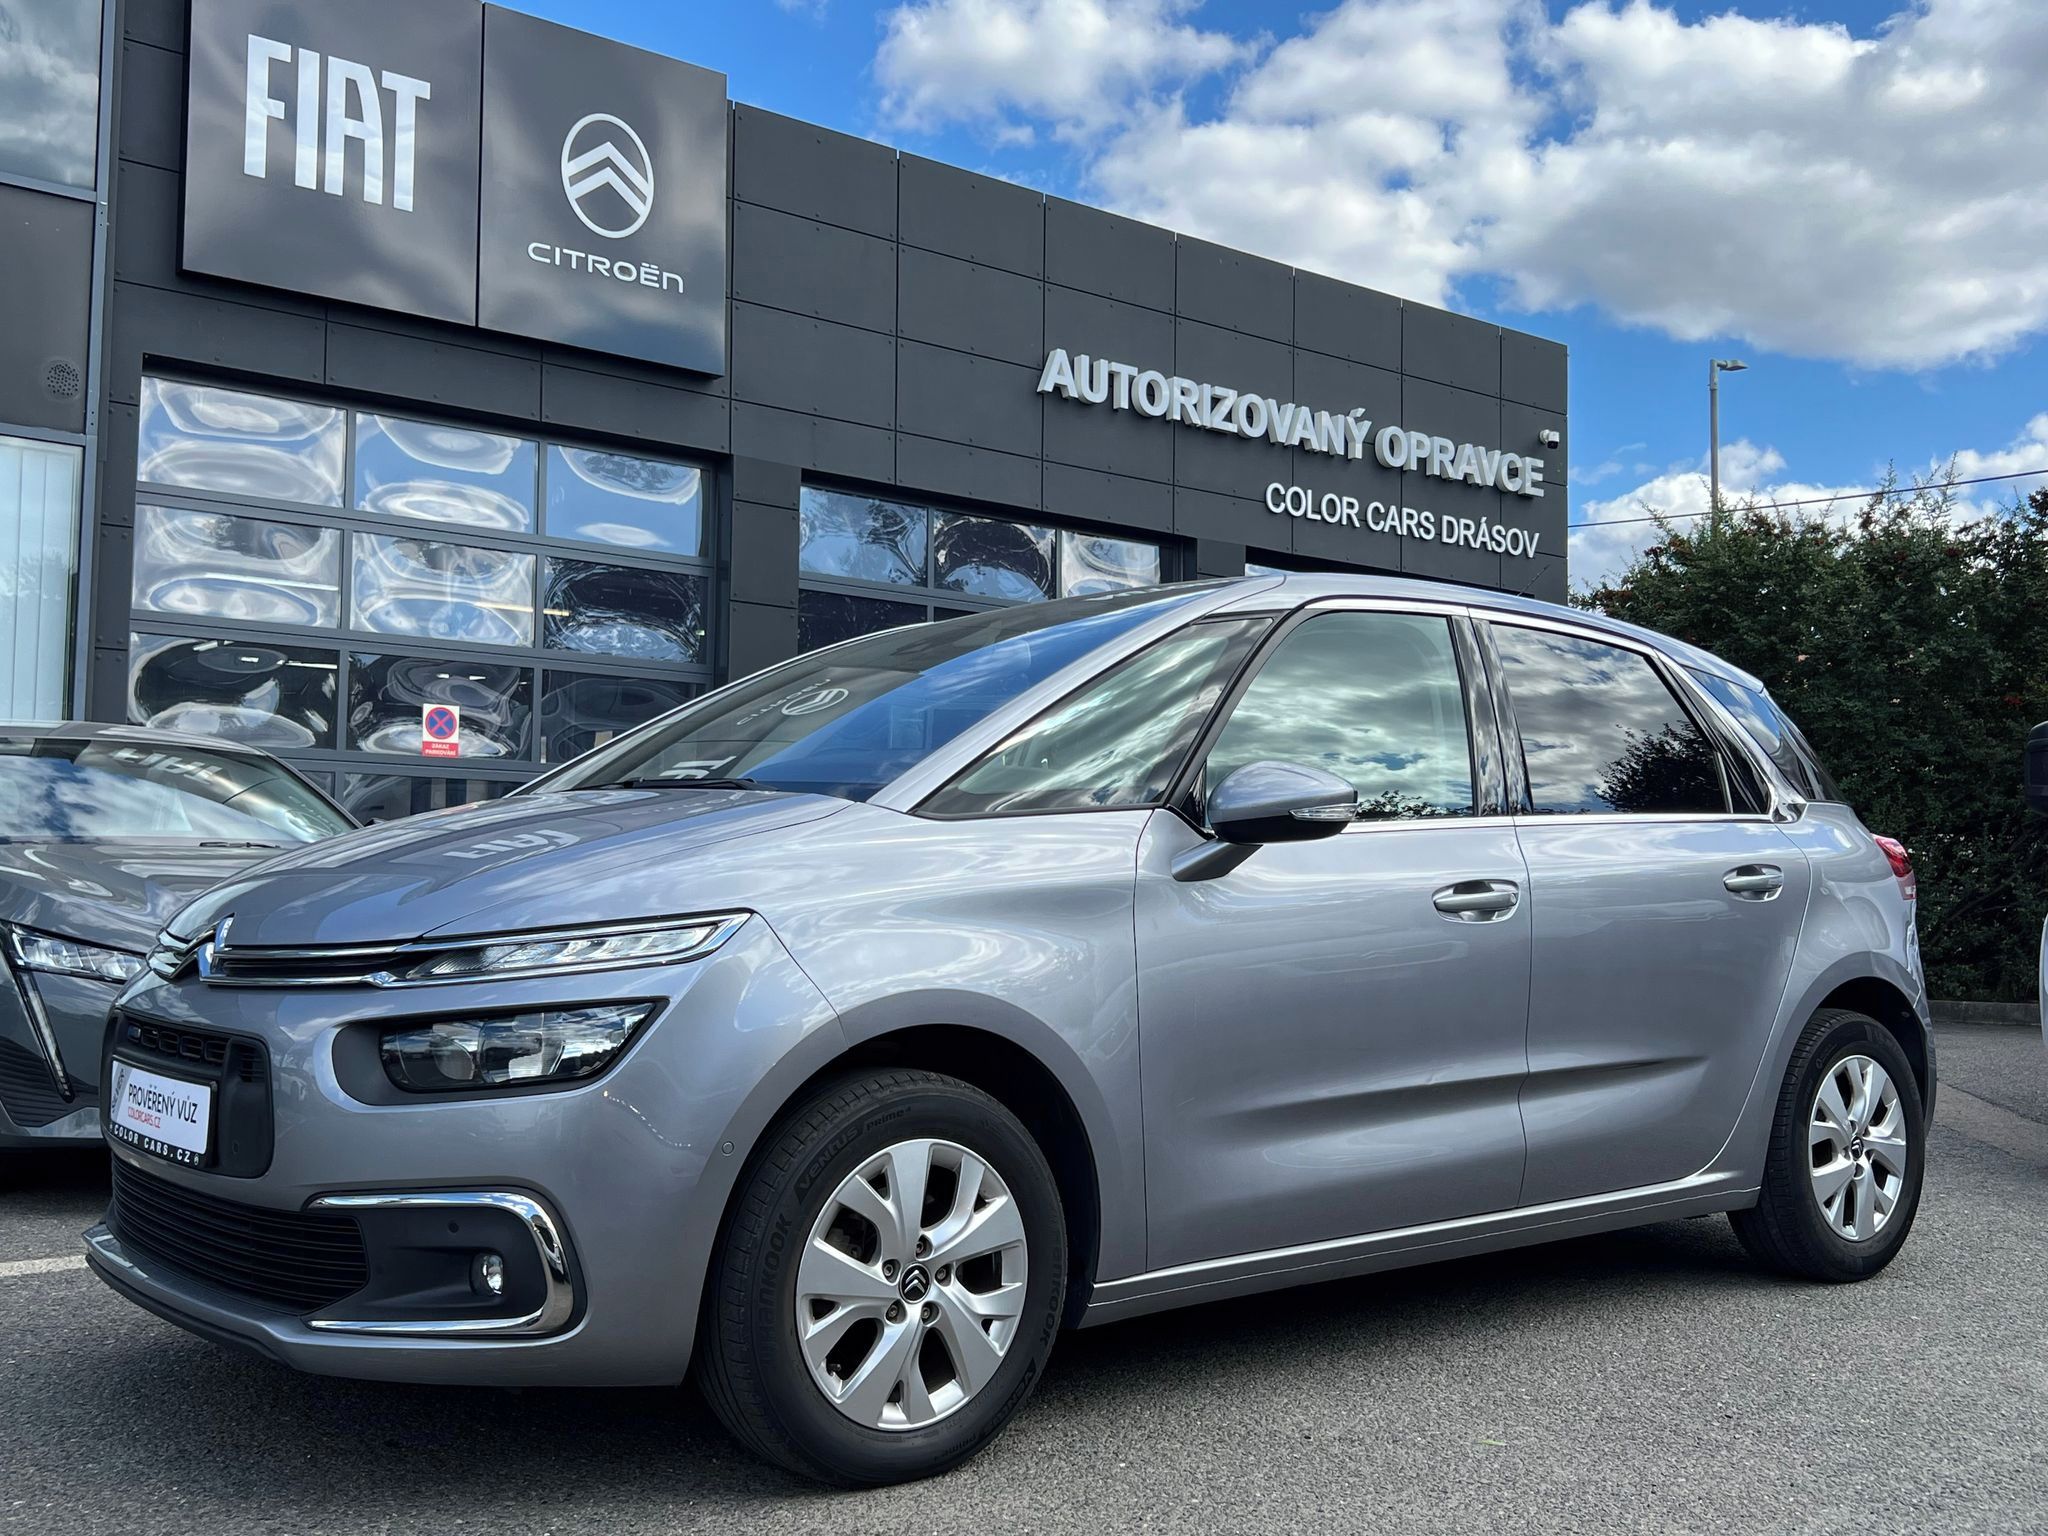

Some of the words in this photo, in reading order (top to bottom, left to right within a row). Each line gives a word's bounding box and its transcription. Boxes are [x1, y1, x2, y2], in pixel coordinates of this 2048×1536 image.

[243, 33, 431, 213] FIAT
[527, 241, 684, 294] CITROËN
[1037, 348, 1372, 460] AUTORIZOVANÝ
[1375, 426, 1545, 497] OPRAVCE
[1265, 482, 1361, 528] COLOR
[1366, 501, 1436, 540] CARS
[1441, 516, 1540, 558] DRÁSOV
[114, 1123, 139, 1145] COLOR
[128, 1083, 177, 1117] PROVĚŘENÝ
[177, 1095, 199, 1124] VŮZ
